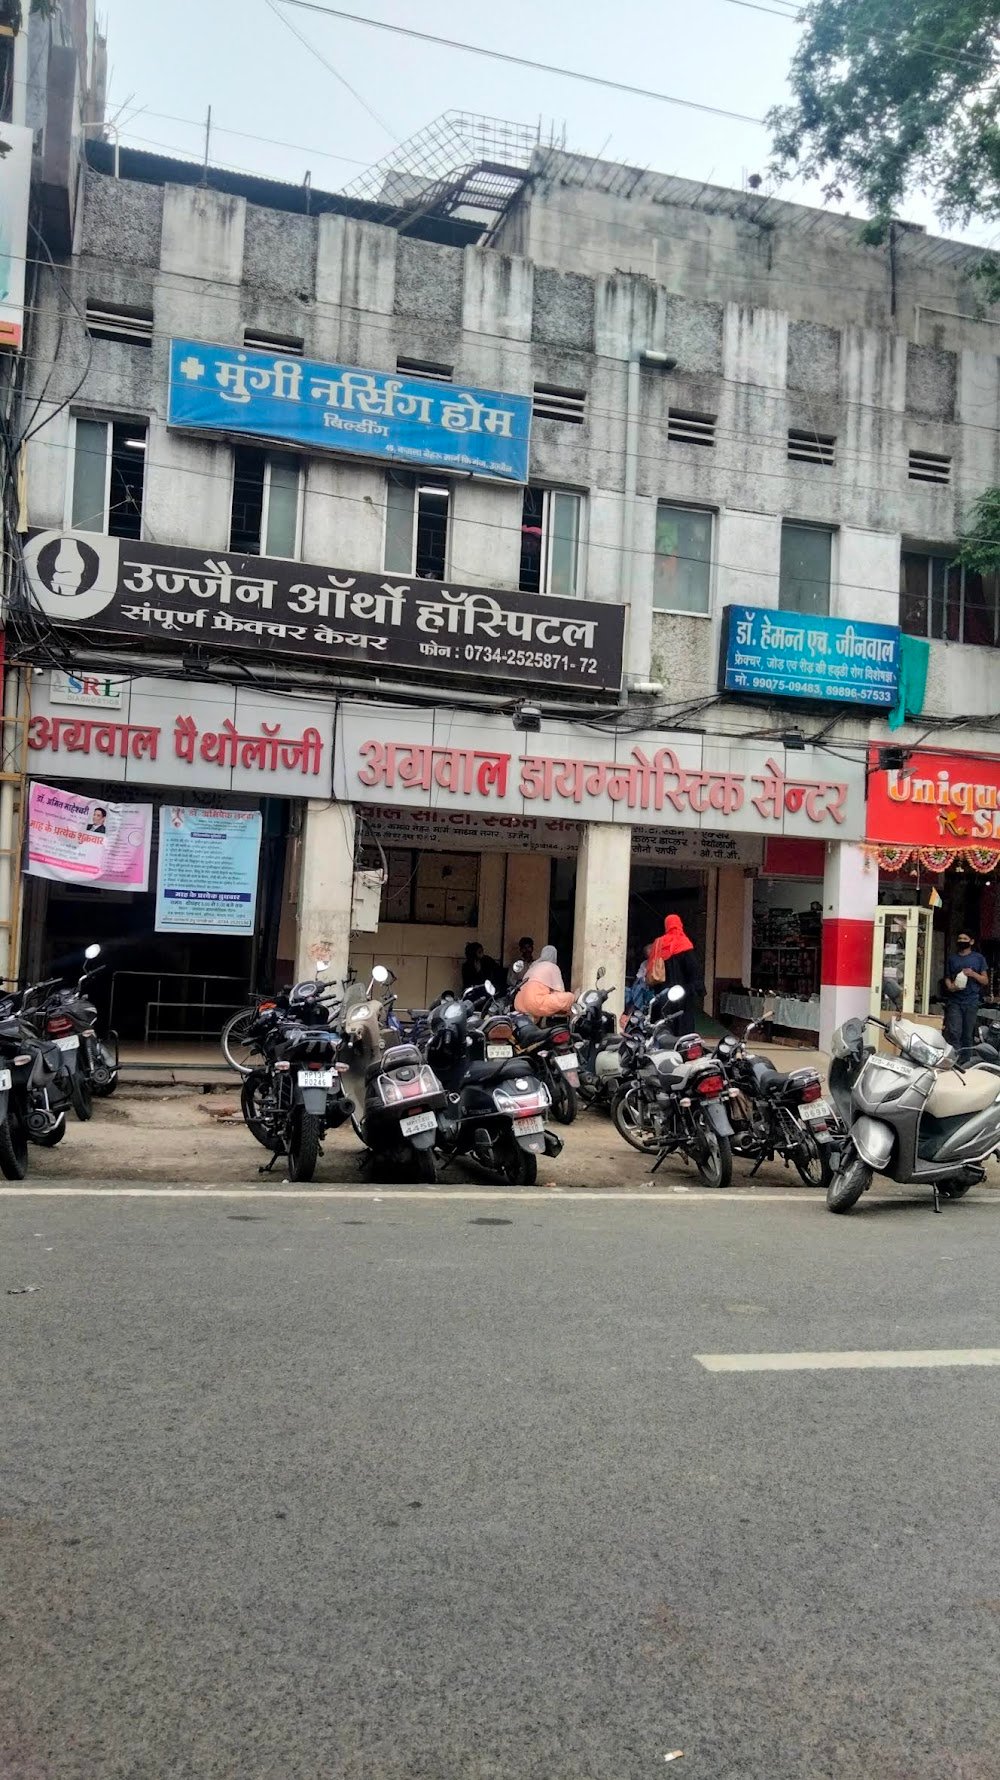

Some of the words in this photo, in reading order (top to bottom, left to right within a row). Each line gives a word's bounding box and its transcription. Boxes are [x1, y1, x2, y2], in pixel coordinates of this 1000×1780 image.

[215, 354, 303, 403] मुंगी
[310, 373, 433, 421] नर्सिंग
[440, 393, 515, 438] होम
[323, 412, 390, 438] बिल्डींग
[121, 602, 209, 632] संपूर्ण
[313, 623, 389, 650] केयर
[123, 558, 278, 610] उज्जैन
[287, 574, 411, 626] ऑर्थो
[416, 590, 598, 649] हॉस्पिटल
[419, 639, 451, 658] फोन
[579, 657, 598, 674] 72
[735, 611, 756, 646] डॉ.
[760, 615, 805, 651] हेमन्त
[807, 630, 831, 657] एच.
[836, 625, 895, 662] जीनवाल
[68, 674, 119, 698] SRL
[735, 674, 749, 687] मो.
[851, 663, 864, 679] रोग
[28, 716, 161, 760] अग्रवाल
[174, 715, 323, 775] पैथोलॉजी
[357, 740, 511, 798] अग्रवाल
[519, 746, 745, 816] डायग्नोस्टिक
[752, 757, 848, 824] सेन्टर
[886, 769, 1000, 815] Uniqu
